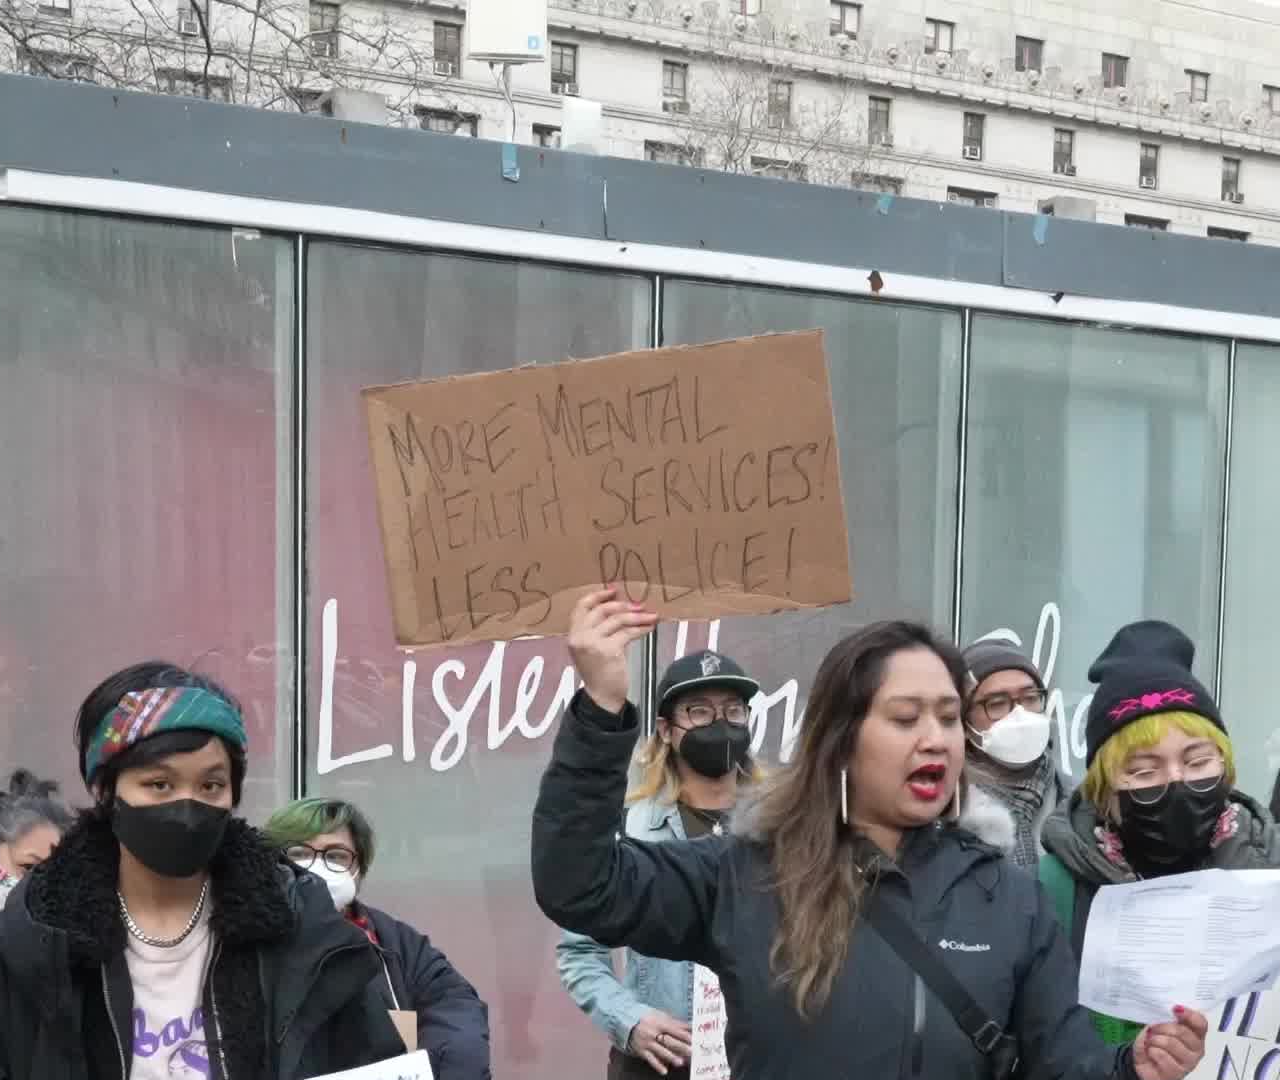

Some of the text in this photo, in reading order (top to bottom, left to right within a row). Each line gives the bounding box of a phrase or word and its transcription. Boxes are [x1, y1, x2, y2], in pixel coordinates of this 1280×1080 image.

[388, 375, 729, 497] MORE MENTAL
[407, 435, 833, 572] HEALTH SERVICES!
[431, 526, 798, 642] LESS POLICE!
